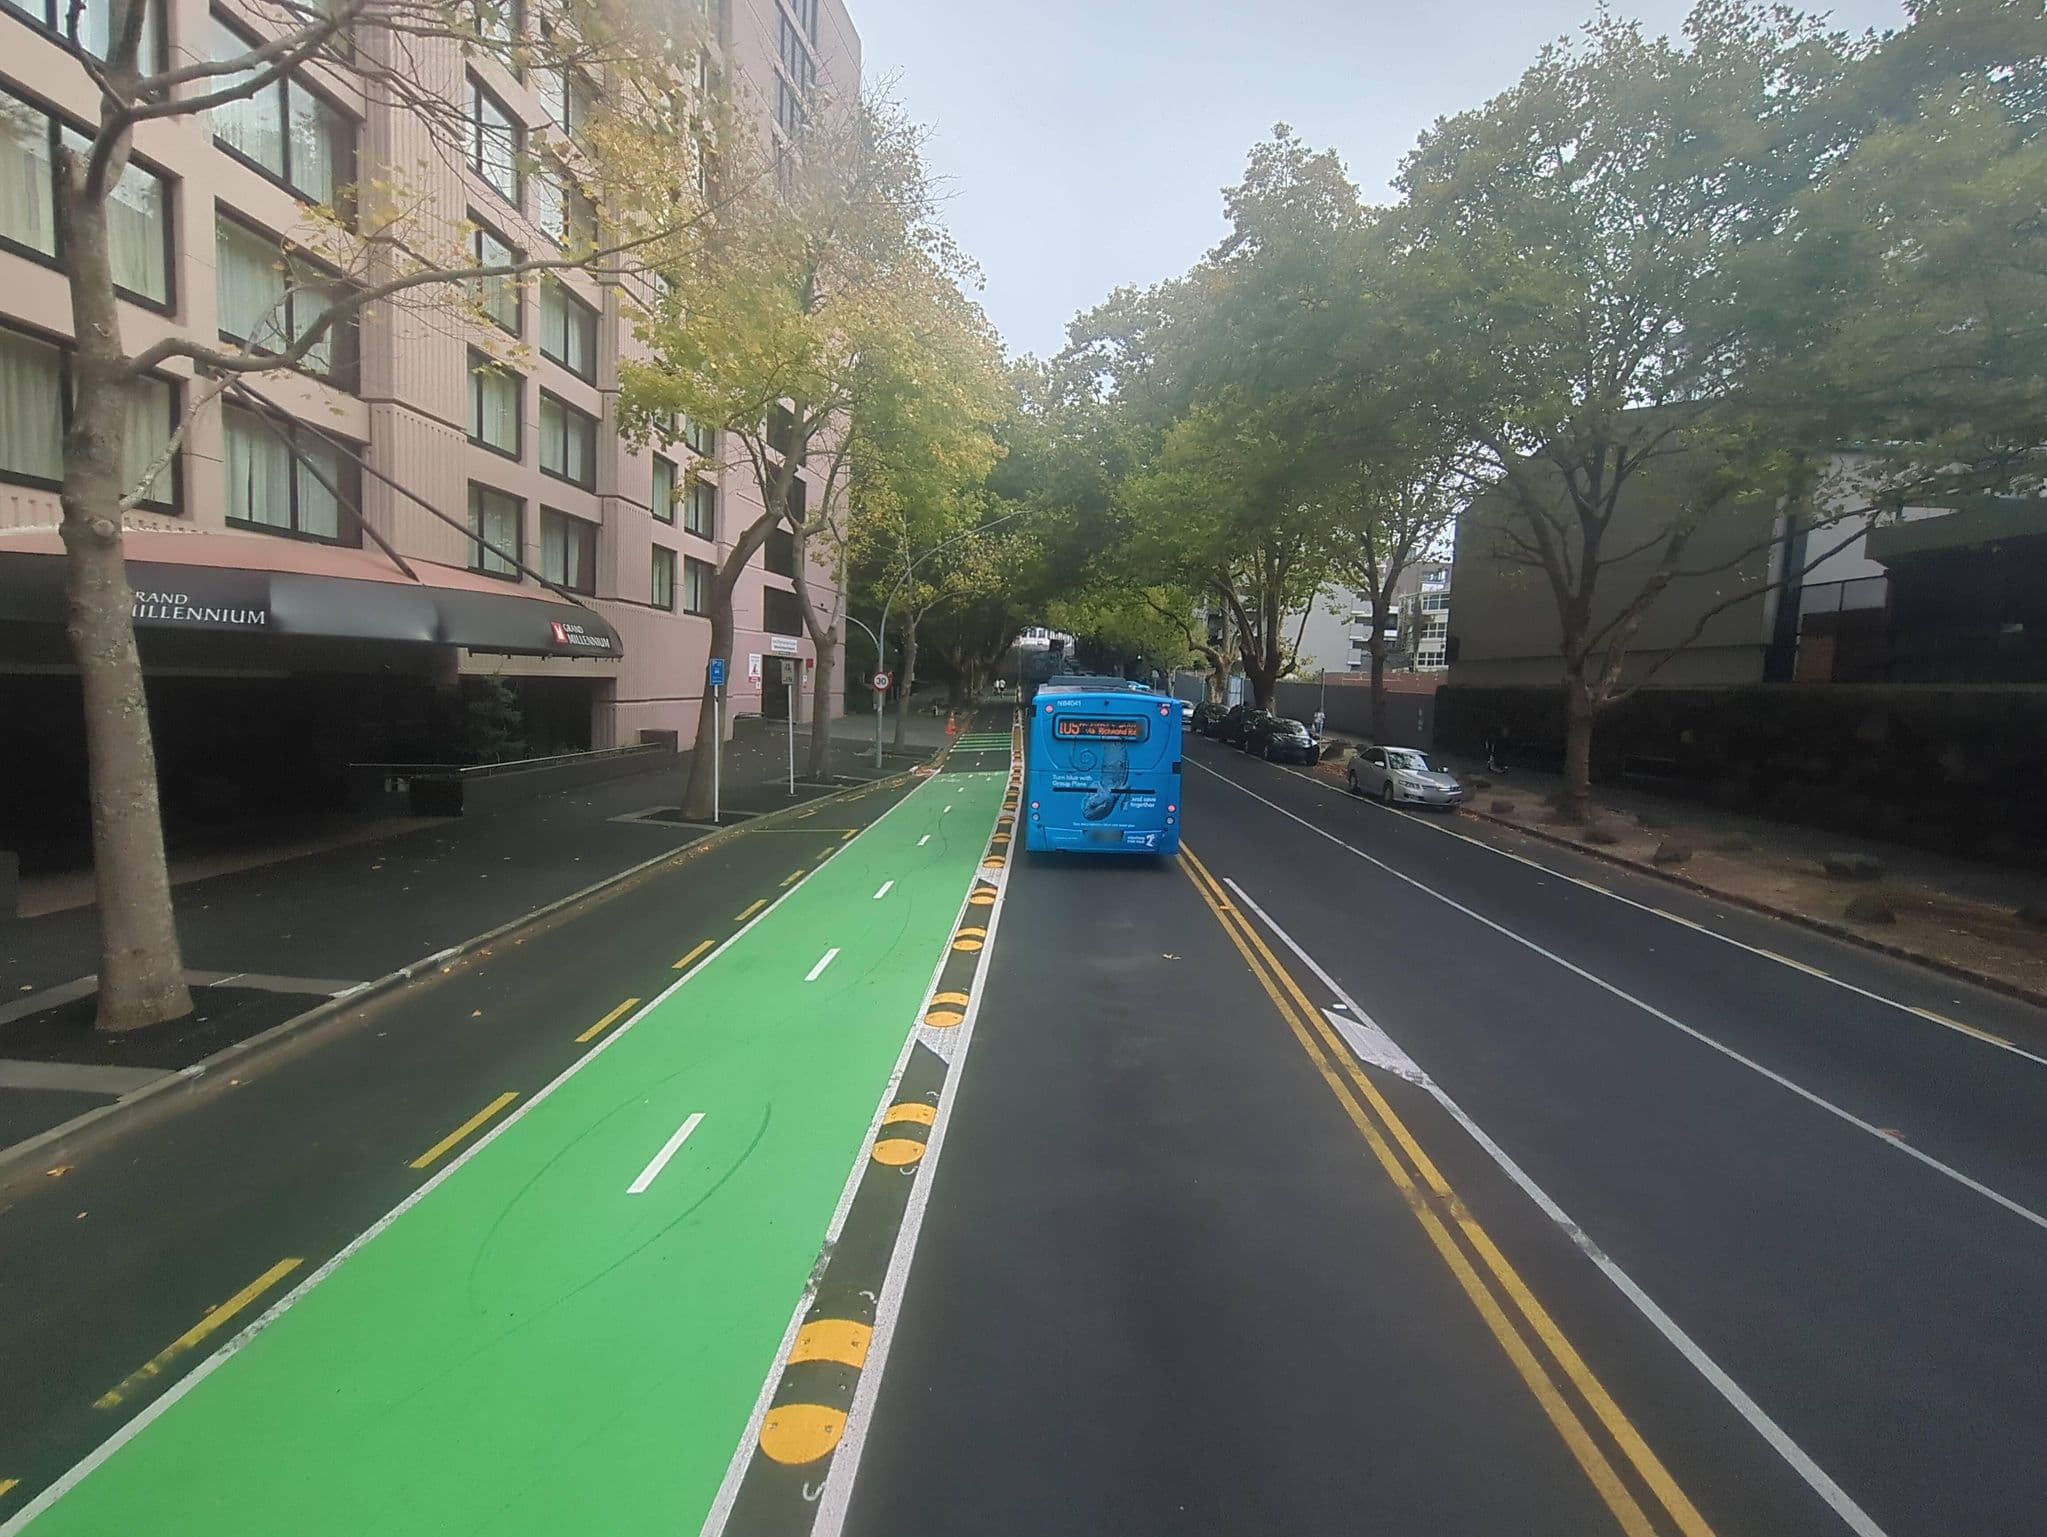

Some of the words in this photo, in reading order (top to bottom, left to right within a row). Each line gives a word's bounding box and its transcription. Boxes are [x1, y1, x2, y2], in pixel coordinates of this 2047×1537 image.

[135, 591, 189, 605] RAND
[562, 623, 584, 634] GRAND
[567, 633, 611, 648] MILLENNIUM
[876, 677, 887, 685] 30
